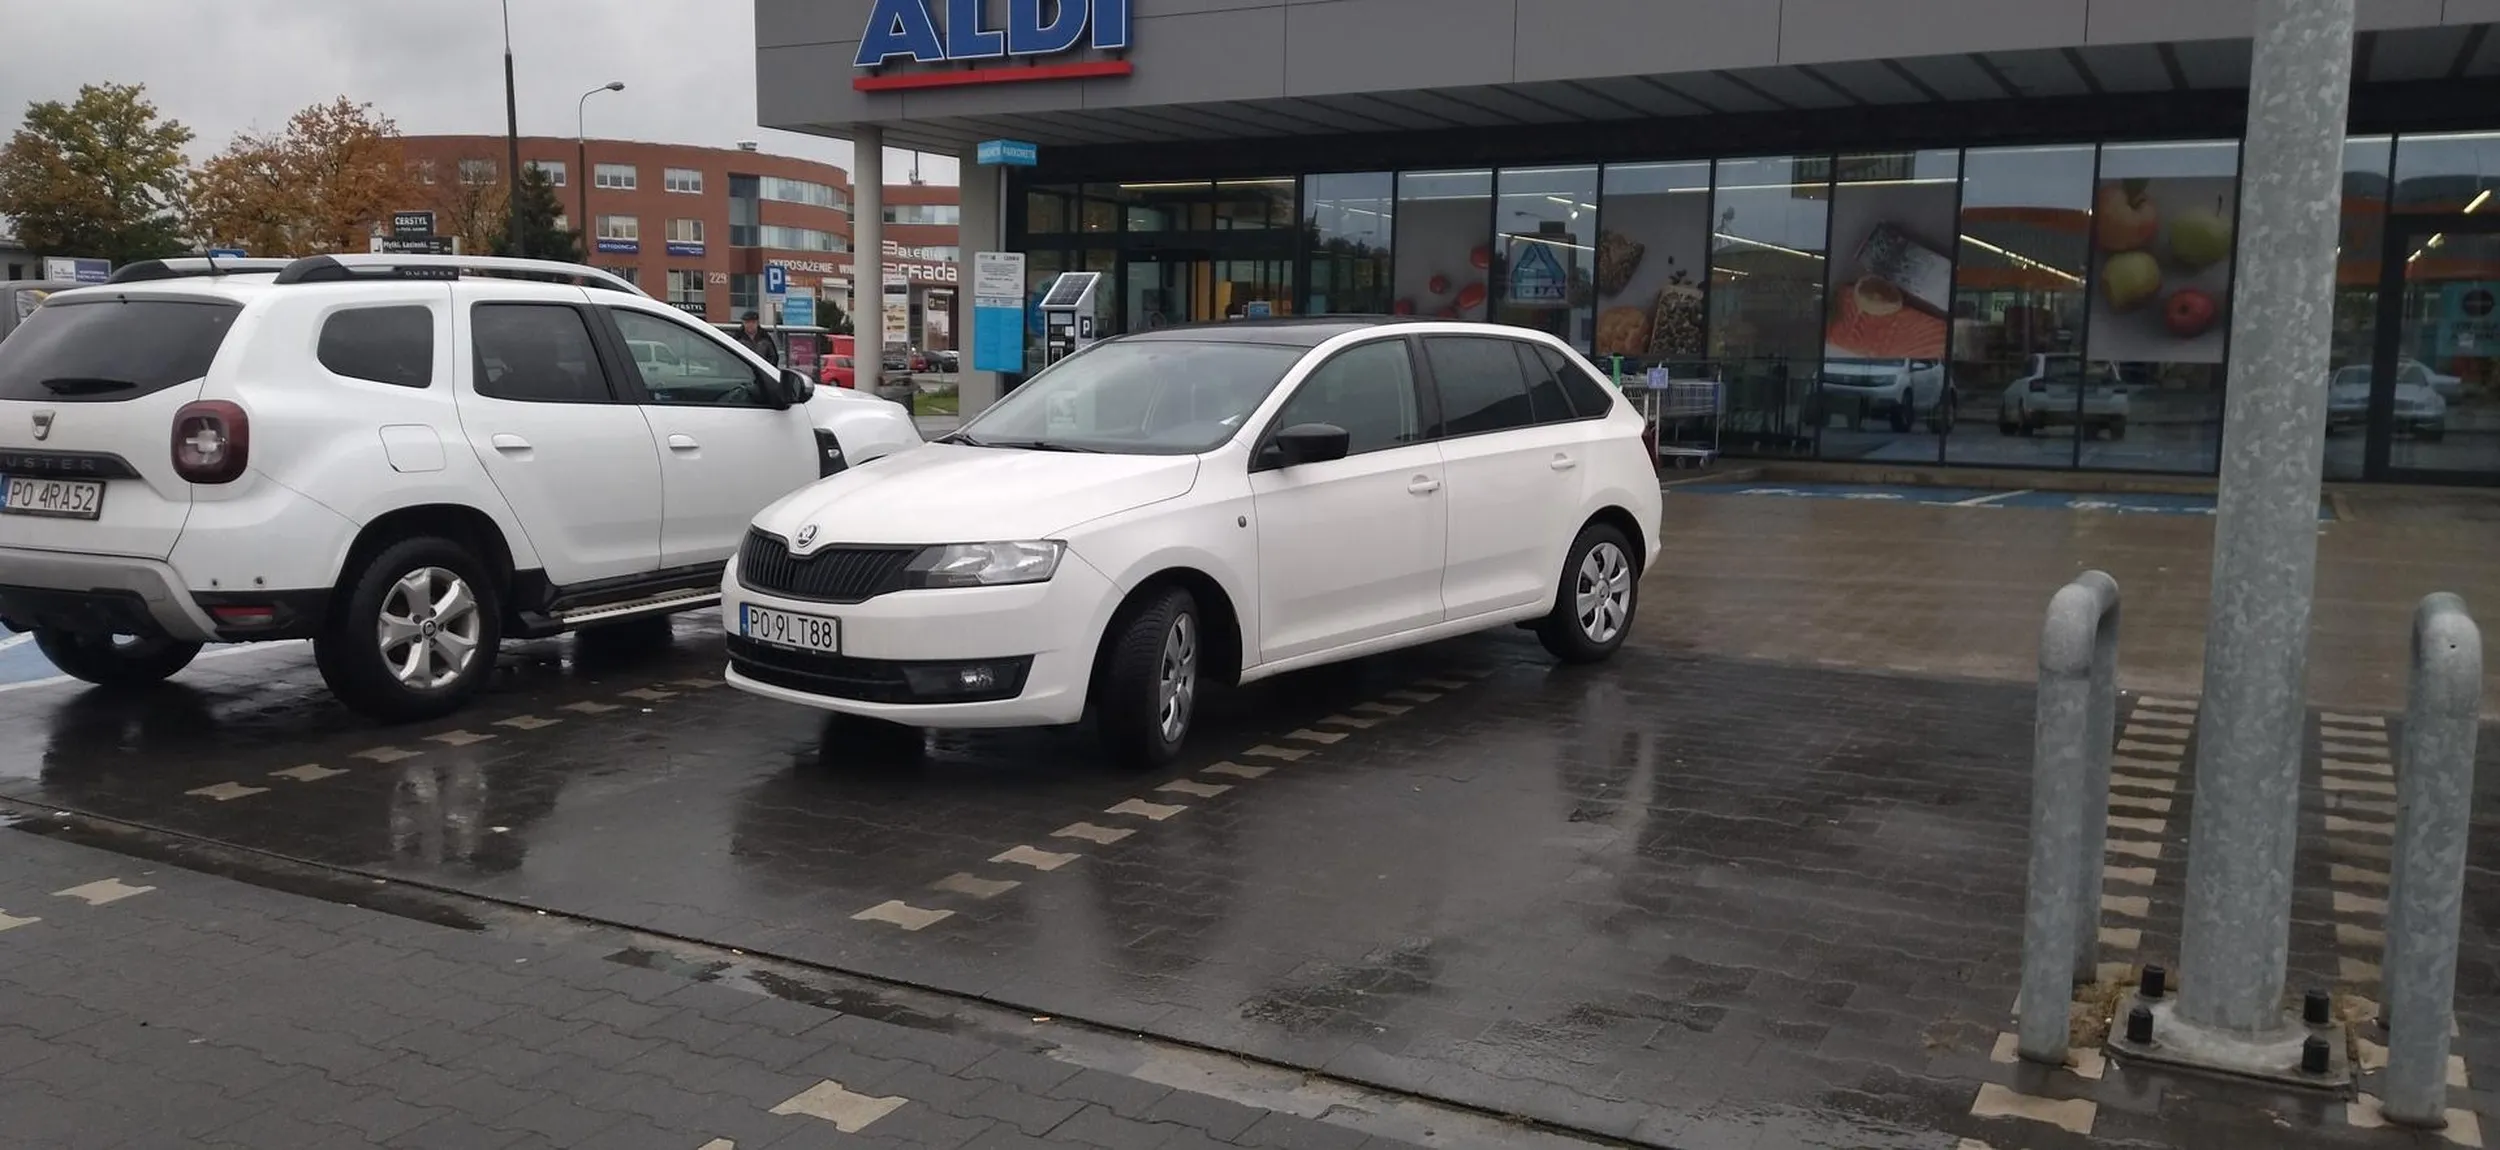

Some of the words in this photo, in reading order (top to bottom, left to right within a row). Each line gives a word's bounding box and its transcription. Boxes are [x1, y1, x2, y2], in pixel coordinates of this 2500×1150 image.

[853, 0, 1125, 67] ALDI
[395, 216, 428, 225] CERSTYL
[709, 272, 727, 285] 229
[769, 268, 782, 291] P
[1082, 319, 1091, 335] P
[6, 456, 95, 471] USTER
[9, 480, 34, 506] PO
[39, 483, 95, 511] 4RA52
[749, 609, 770, 637] PO
[776, 615, 832, 648] 9LT88
